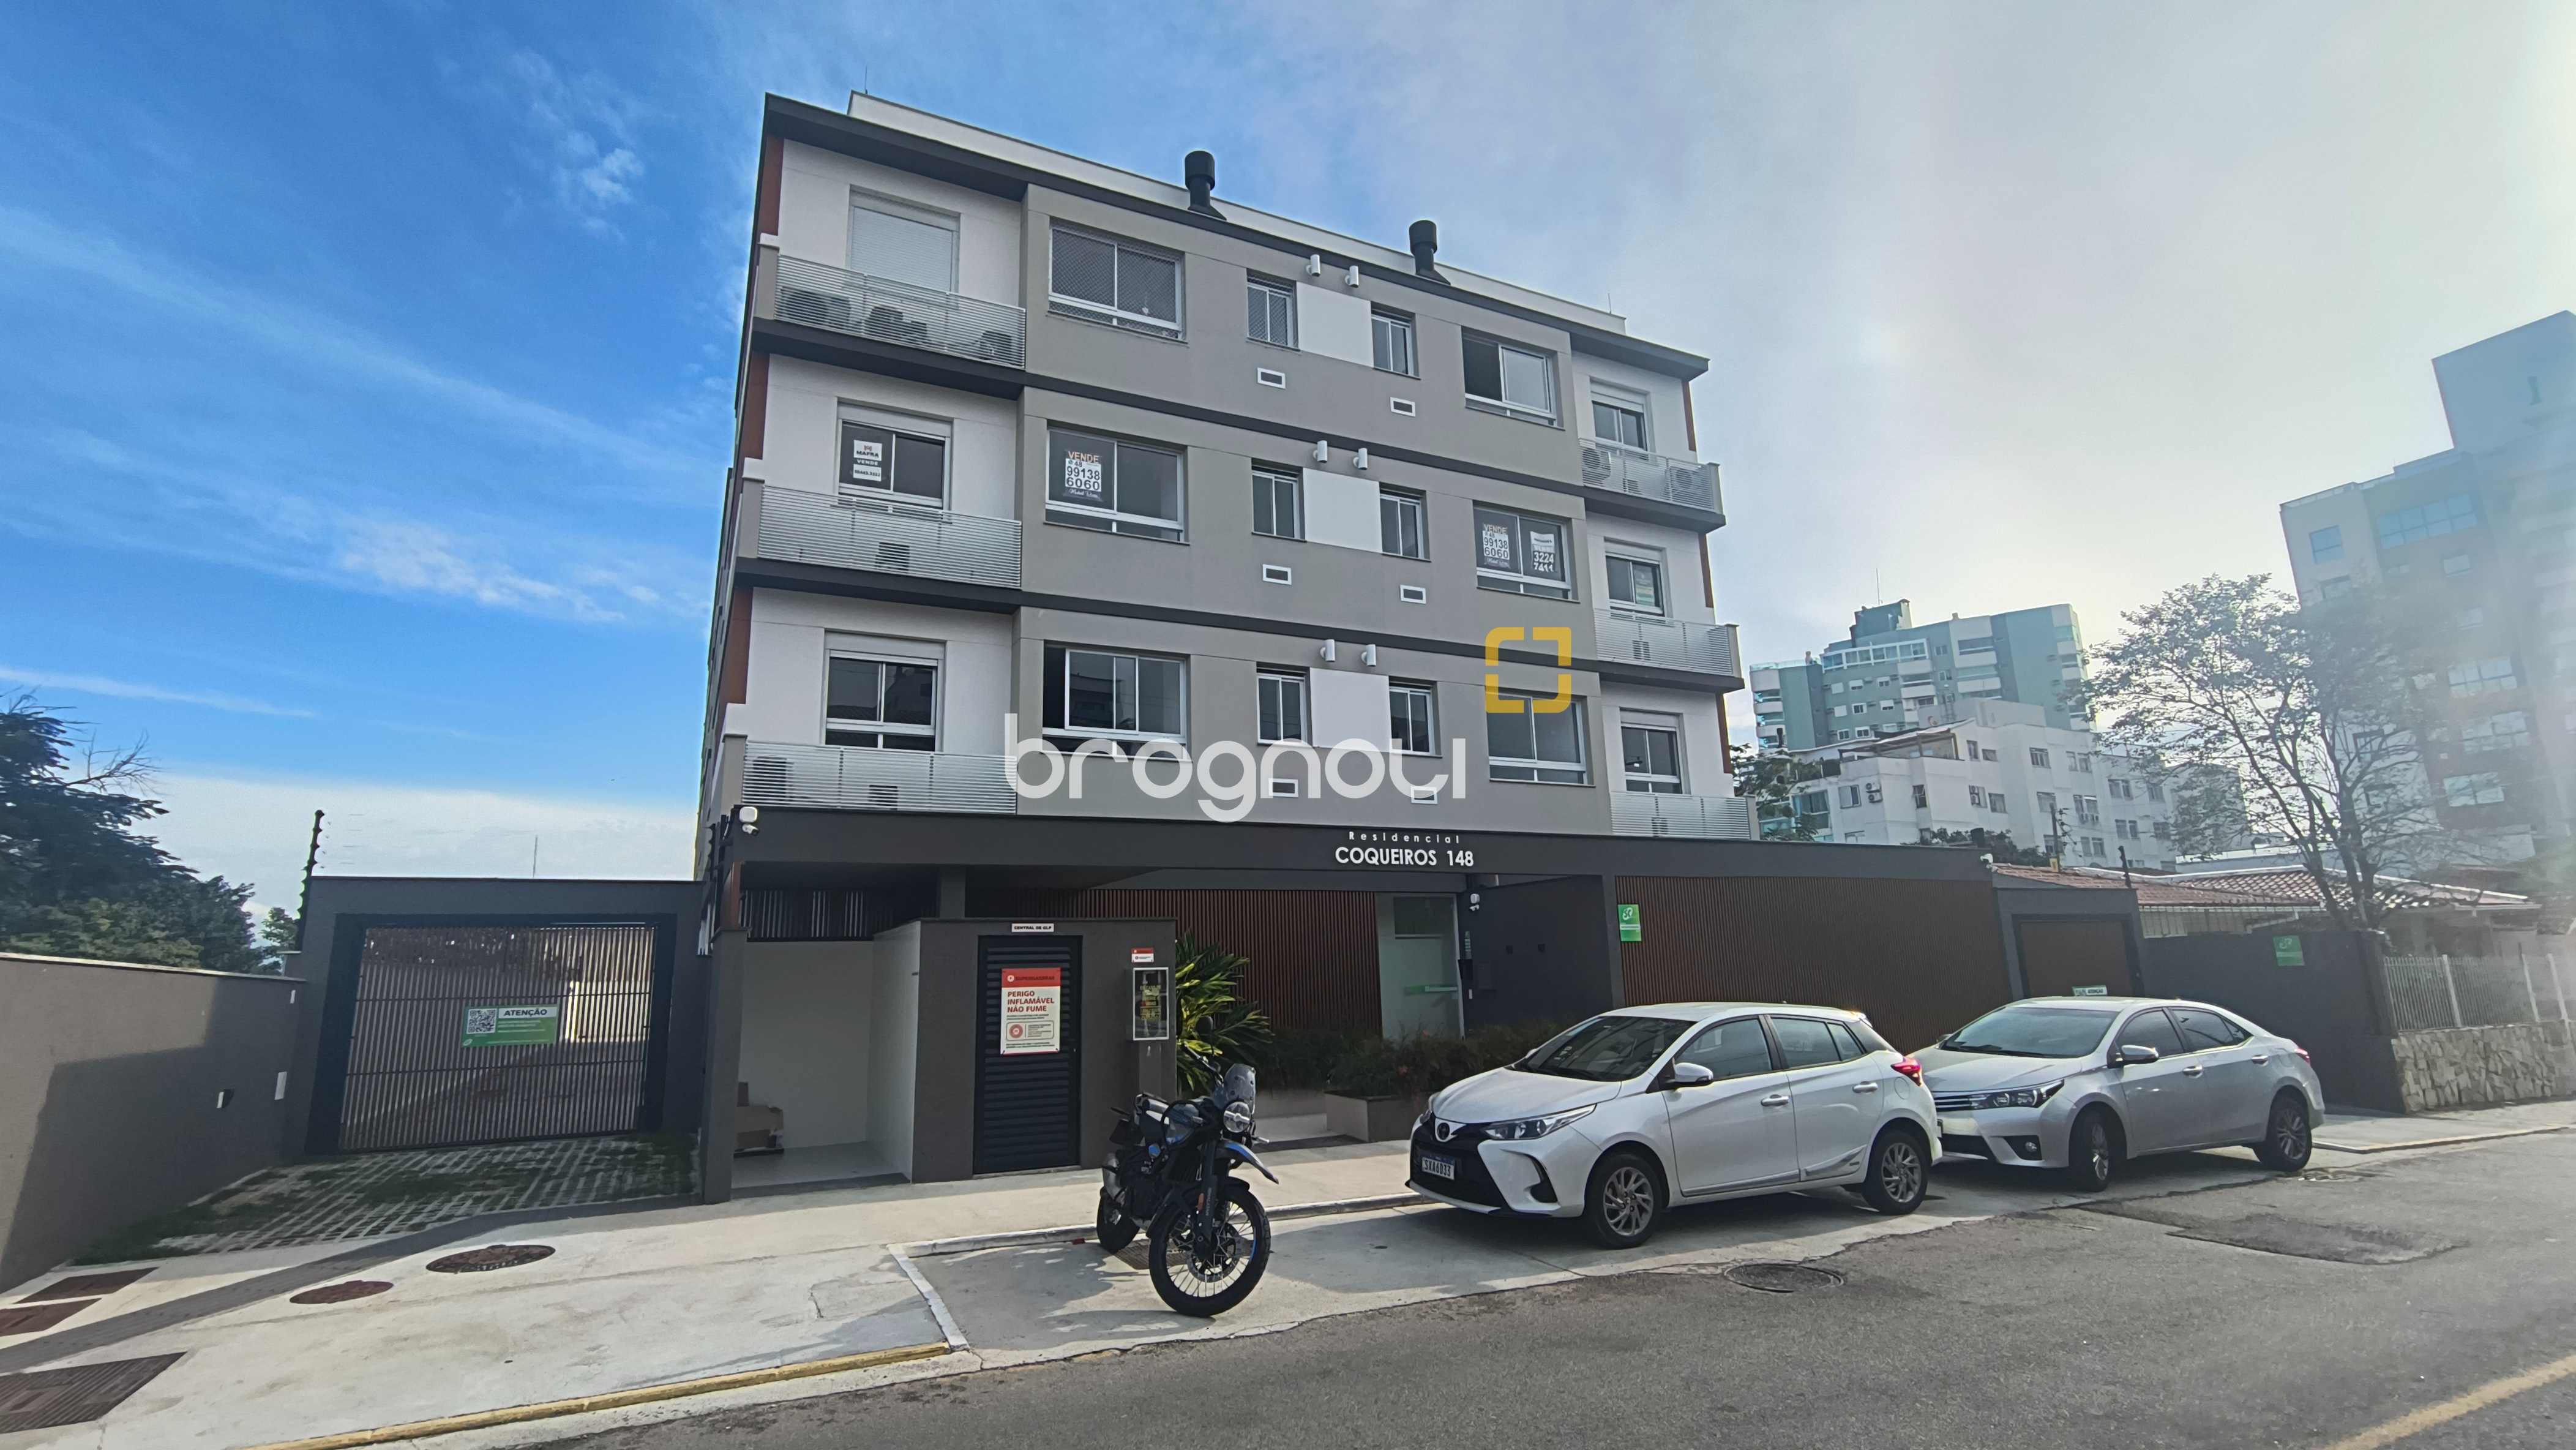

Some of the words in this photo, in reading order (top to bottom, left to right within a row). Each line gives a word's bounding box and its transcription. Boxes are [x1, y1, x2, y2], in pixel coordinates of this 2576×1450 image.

[1068, 451, 1099, 463] VENDE
[1067, 465, 1100, 481] 99138
[1066, 477, 1100, 490] 6060
[1484, 524, 1507, 534] VENDE
[1484, 537, 1508, 549] 99138
[1485, 547, 1509, 558] 6060
[1534, 552, 1554, 564] 3224
[1533, 562, 1554, 573] 7411
[1349, 831, 1459, 844] Residencial
[1335, 846, 1437, 866] COQUEIROS
[1447, 850, 1474, 866] 148
[1007, 996, 1055, 1005] INFLAMÁVEL
[504, 1009, 547, 1017] ATENÇÃO
[1425, 1159, 1451, 1177] SXA6D33
